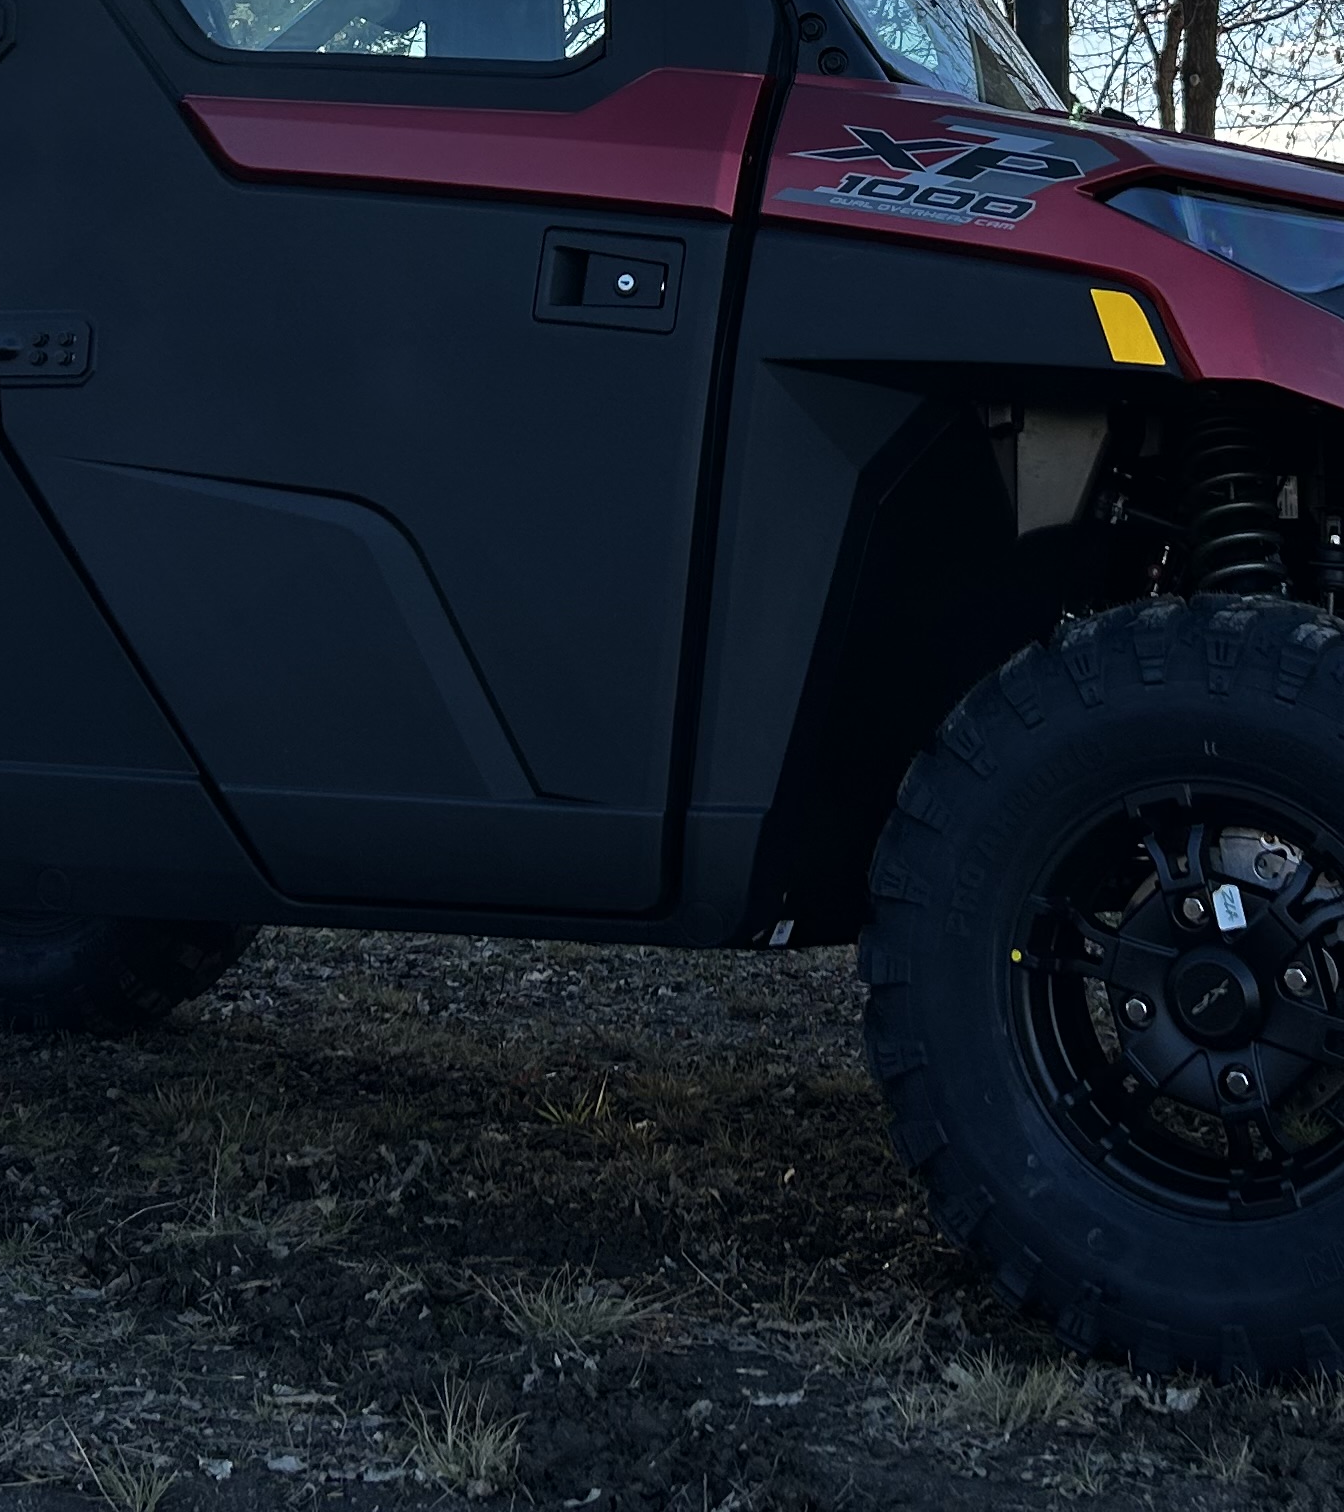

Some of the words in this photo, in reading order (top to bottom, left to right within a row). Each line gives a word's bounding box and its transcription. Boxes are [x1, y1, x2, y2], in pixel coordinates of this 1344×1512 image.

[786, 124, 1085, 180] XP
[829, 196, 873, 210] DUAL
[974, 218, 1016, 231] CAM
[838, 172, 1036, 222] 1000
